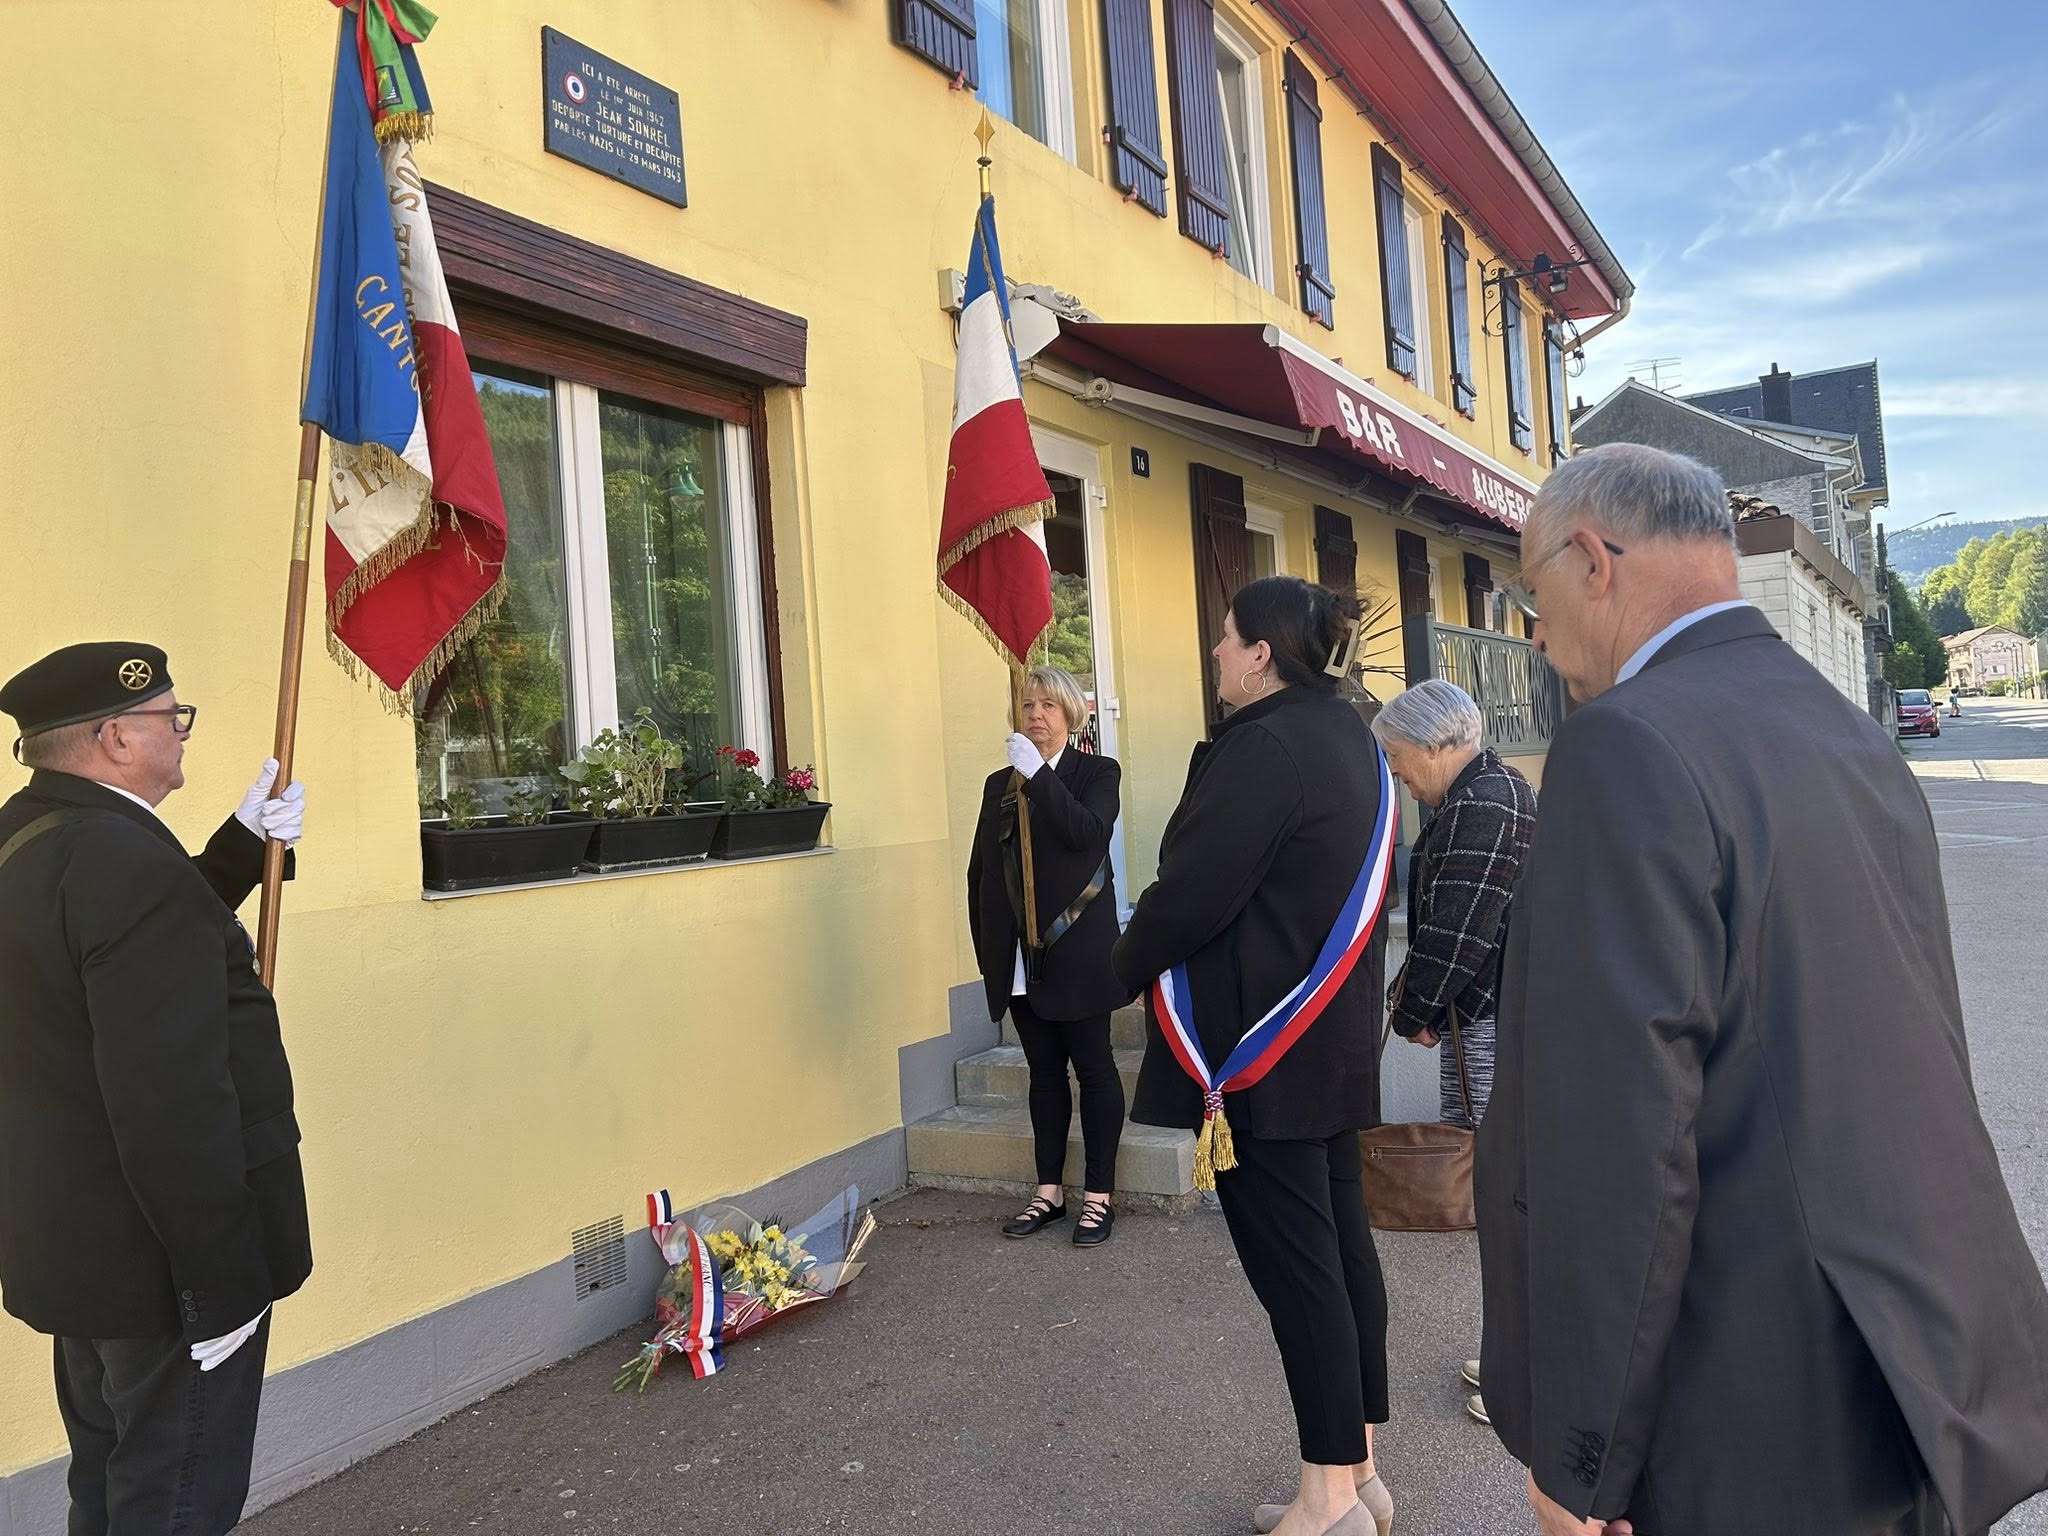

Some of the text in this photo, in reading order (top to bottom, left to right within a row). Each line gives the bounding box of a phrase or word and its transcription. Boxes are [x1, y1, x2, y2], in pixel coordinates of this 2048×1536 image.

[582, 61, 594, 78] ICI
[597, 71, 604, 82] A
[596, 101, 671, 149] JEAN SONREL
[600, 88, 609, 101] LE
[627, 102, 643, 117] JUIN
[646, 110, 665, 128] 1942
[552, 99, 682, 169] DEPORTE TORTURE ET DECAPITE
[554, 118, 682, 183] PAR LES NAZIS LE 29 MARS 1943
[1335, 388, 1404, 459] BAR
[1136, 455, 1145, 471] 16
